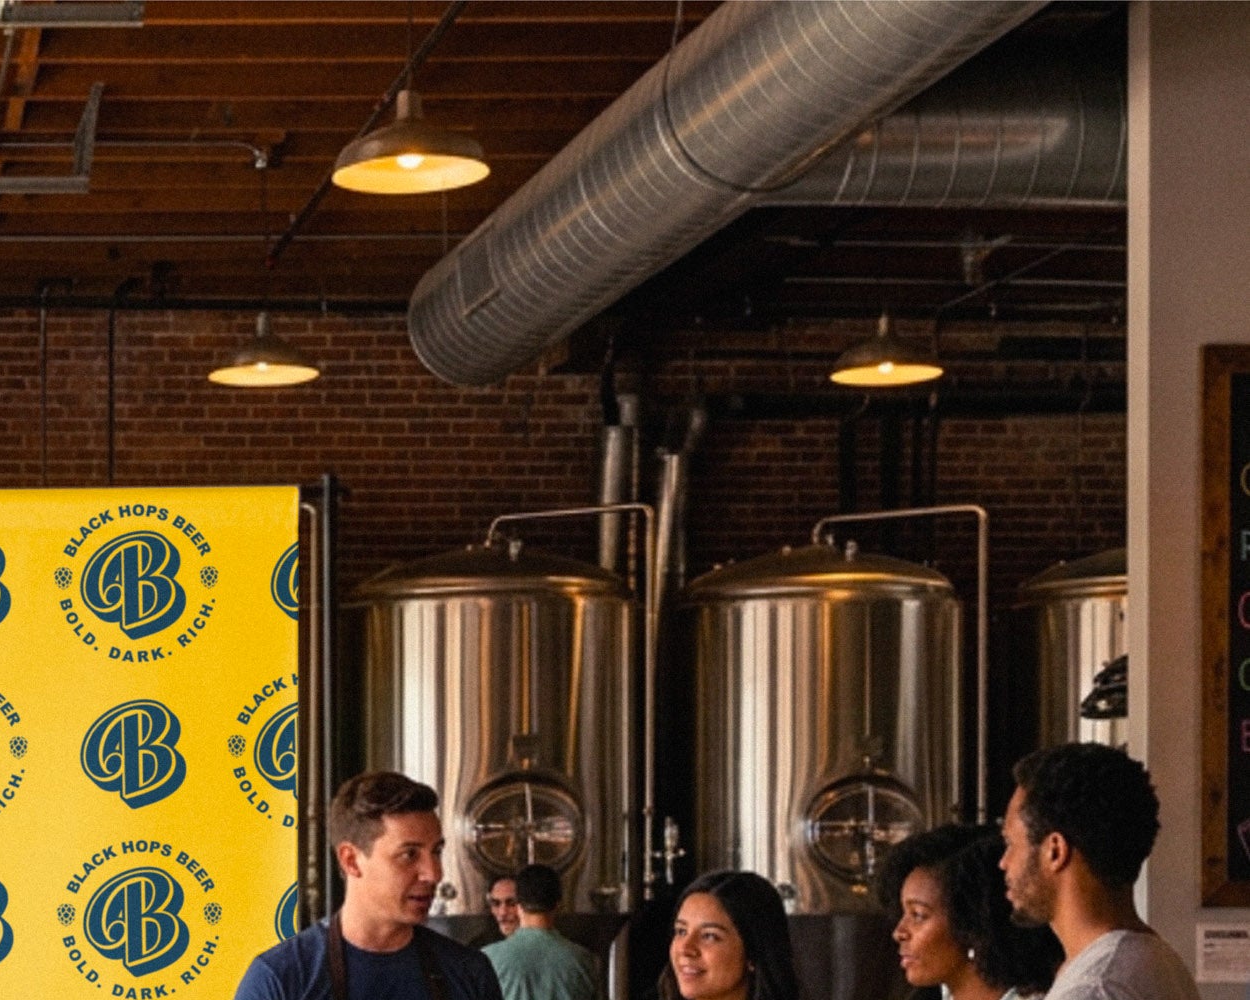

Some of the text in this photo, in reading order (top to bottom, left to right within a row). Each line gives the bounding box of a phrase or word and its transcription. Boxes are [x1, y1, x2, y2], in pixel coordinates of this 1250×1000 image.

[63, 504, 211, 557] BLACK HOPS BEER
[60, 598, 215, 663] BOLD. DARK. RICH.
[237, 677, 287, 725] BLACK
[233, 766, 272, 819] BOLD.
[66, 840, 215, 894] BLACK HOPS BEER
[62, 935, 219, 1000] BOLD. DARK. RICH.
